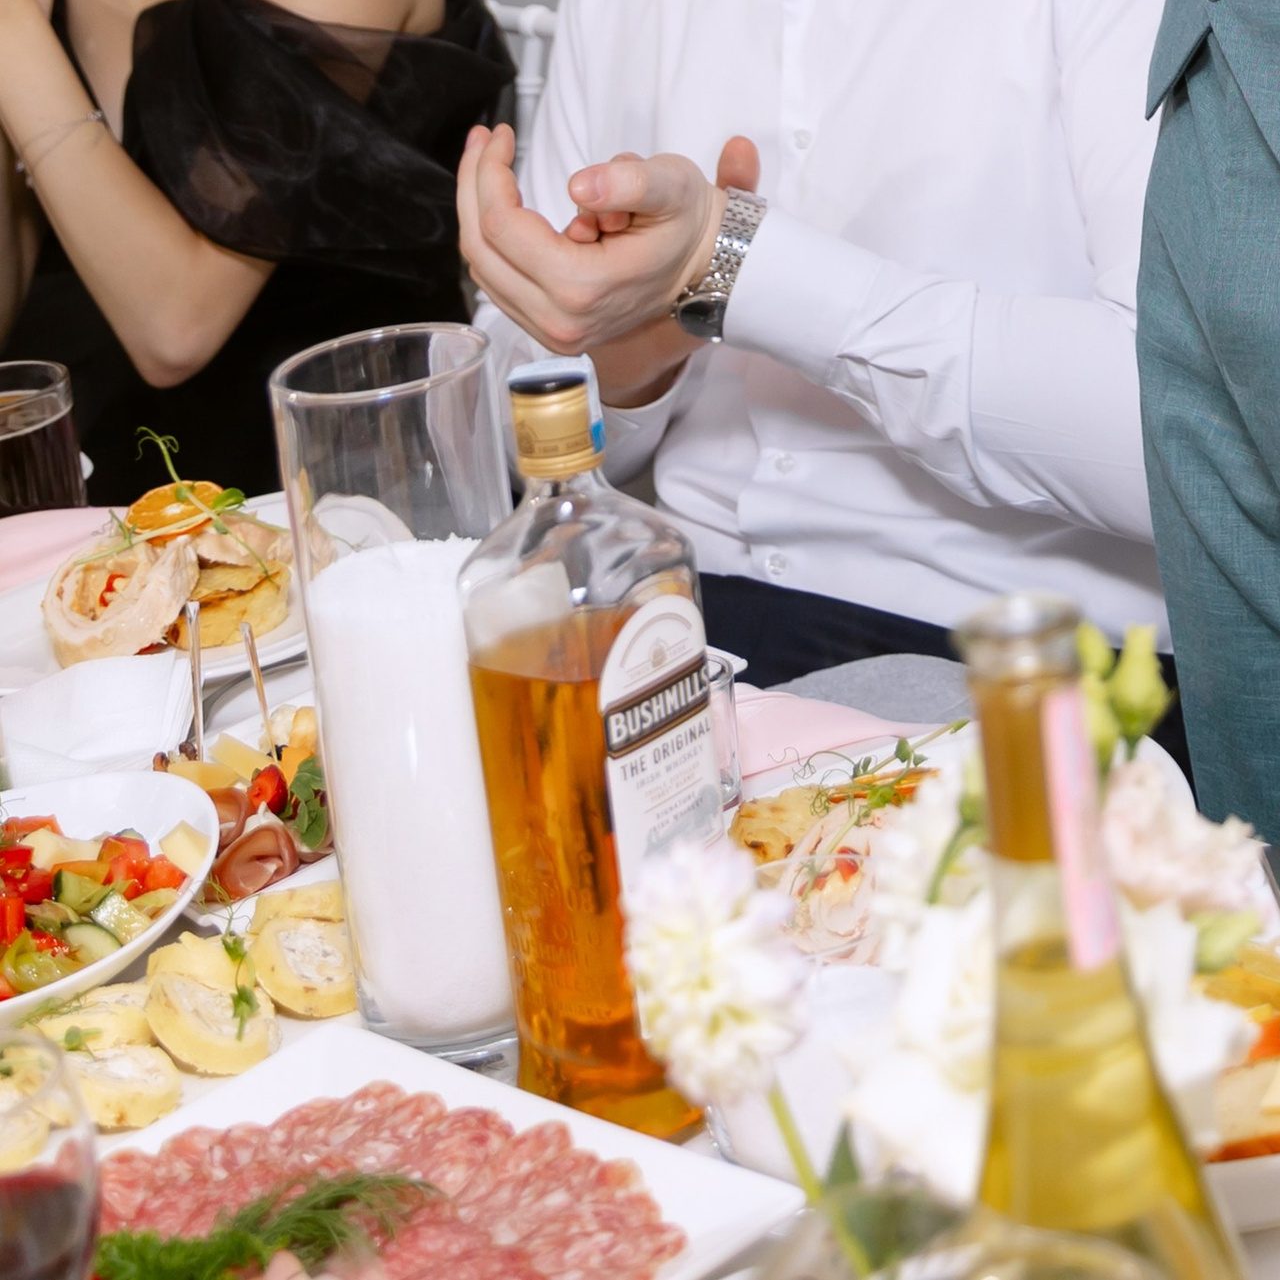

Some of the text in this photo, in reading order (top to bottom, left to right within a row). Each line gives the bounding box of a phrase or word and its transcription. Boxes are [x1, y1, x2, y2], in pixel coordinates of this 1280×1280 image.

[608, 666, 709, 744] BUSHMILLS
[620, 716, 711, 782] THE ORIGINAL
[635, 743, 704, 790] IRISH WHISKEY
